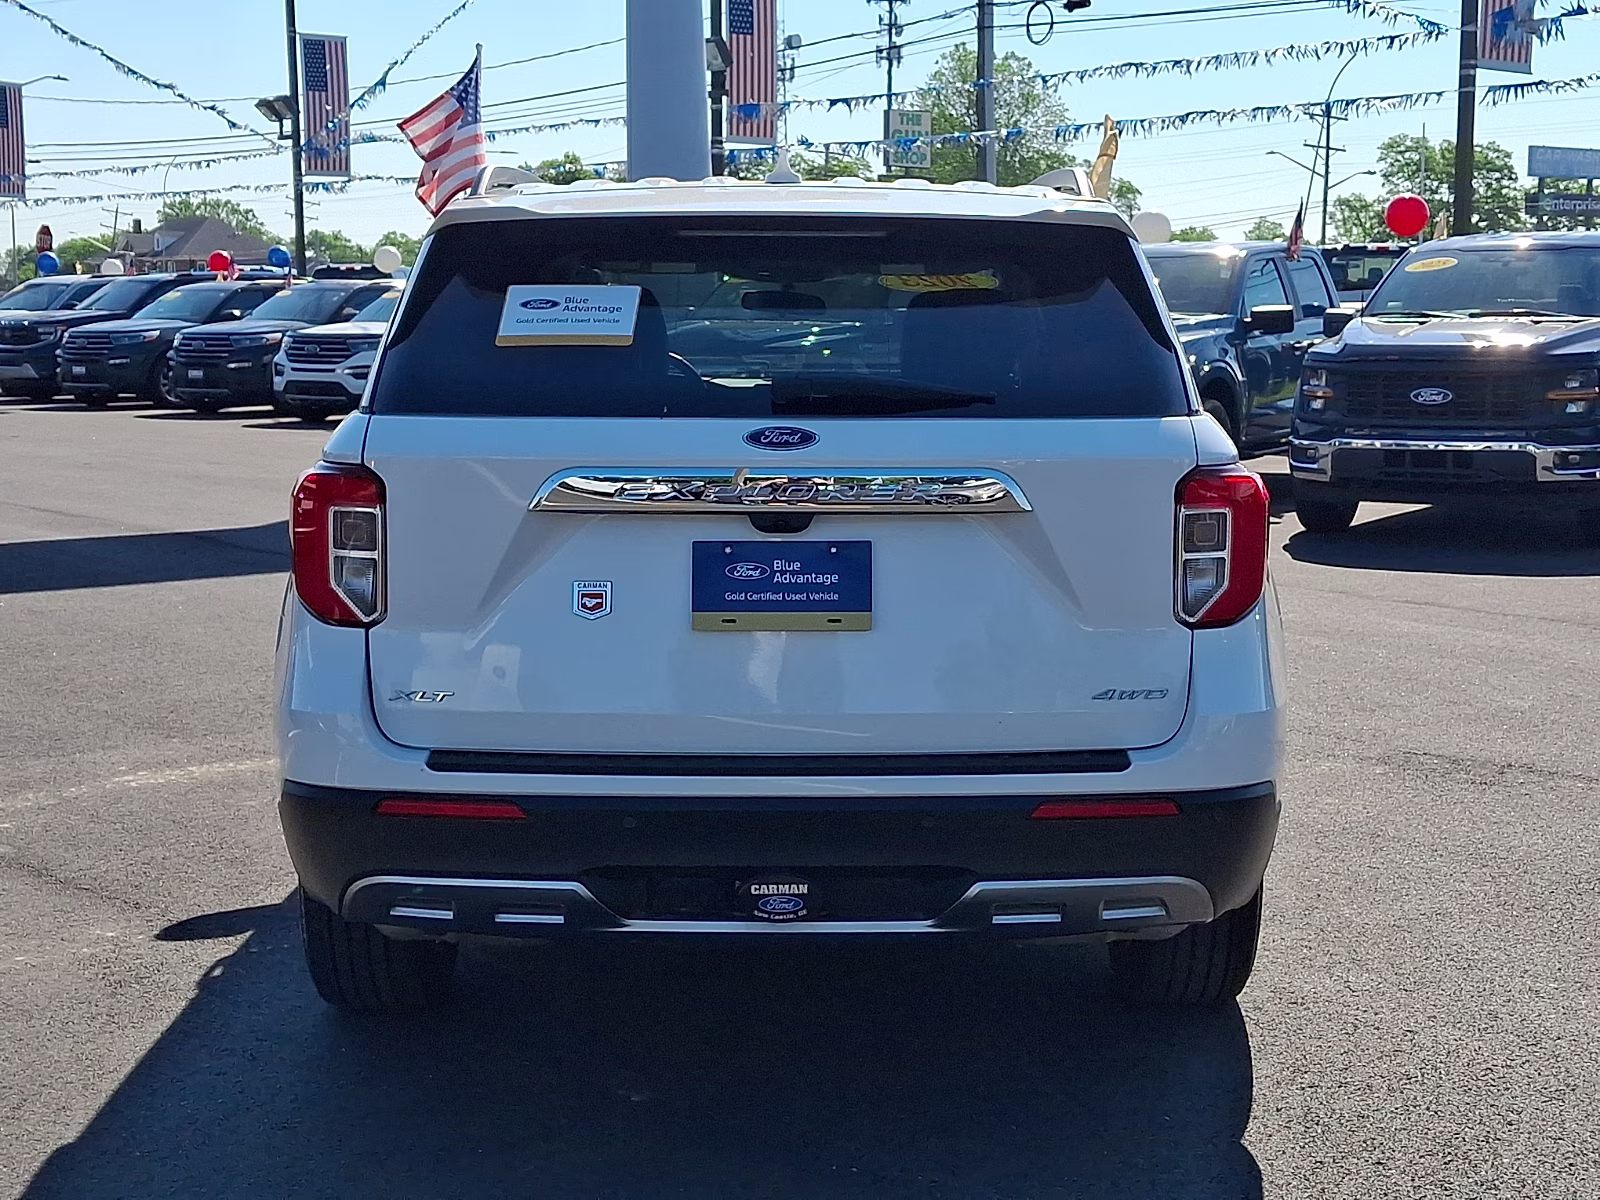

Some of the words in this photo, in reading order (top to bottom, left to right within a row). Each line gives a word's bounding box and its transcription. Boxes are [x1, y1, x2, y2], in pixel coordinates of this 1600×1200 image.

[899, 112, 922, 126] THE
[893, 151, 928, 166] SHOP
[564, 296, 590, 304] Blue
[562, 305, 623, 314] Advantage
[760, 429, 802, 443] Ford
[614, 482, 945, 502] EXPLORER
[733, 563, 762, 577] Ford
[773, 560, 801, 571] Blue
[773, 572, 839, 585] Advantage
[725, 592, 745, 601] Gold
[747, 592, 783, 601] Certified
[785, 592, 807, 601] Used
[809, 592, 839, 601] Vehicle
[388, 690, 455, 702] XLT
[1091, 688, 1169, 700] 4WD
[750, 884, 808, 895] CARMAN
[766, 897, 795, 910] Ford
